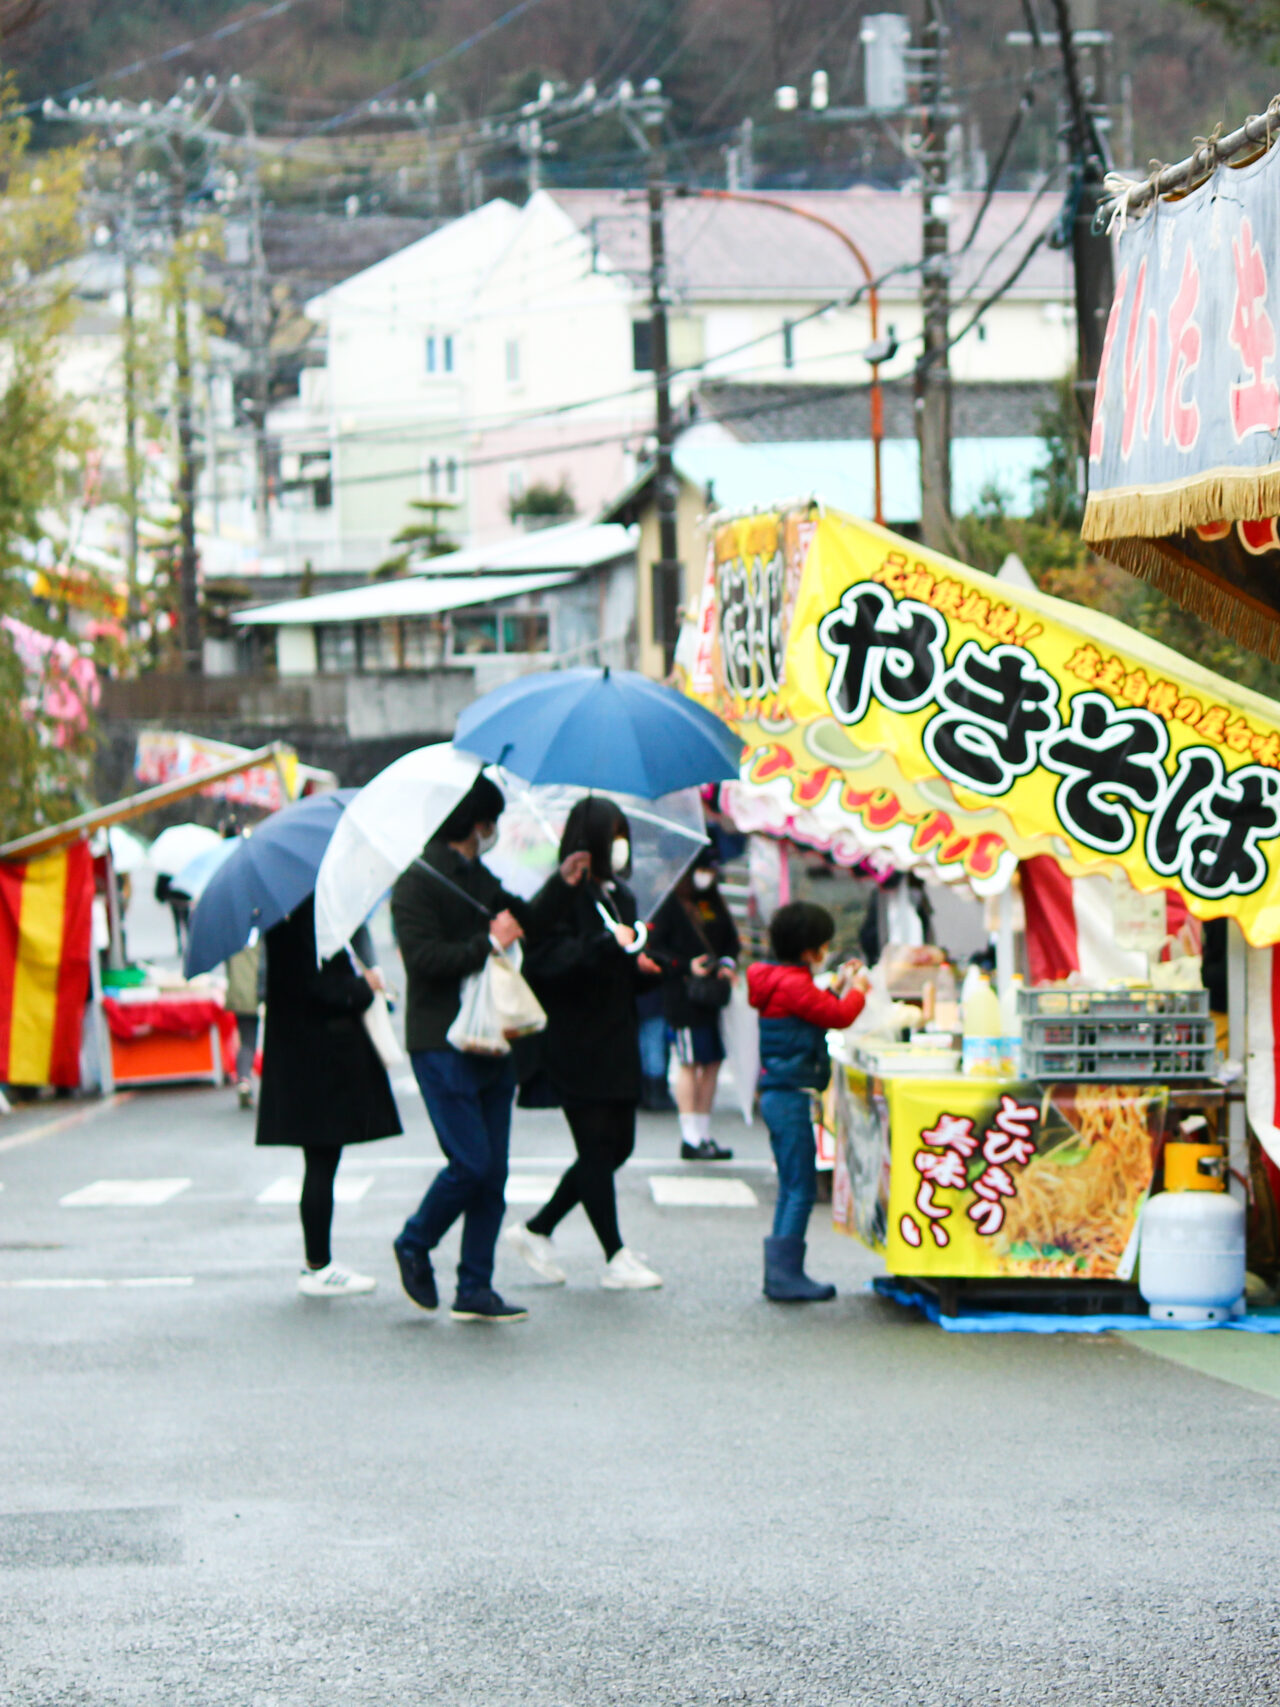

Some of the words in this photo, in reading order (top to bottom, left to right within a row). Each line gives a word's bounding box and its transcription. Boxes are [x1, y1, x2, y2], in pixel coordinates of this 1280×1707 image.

[900, 1111, 981, 1248] 美味しい
[968, 1094, 1040, 1236] とびきり
